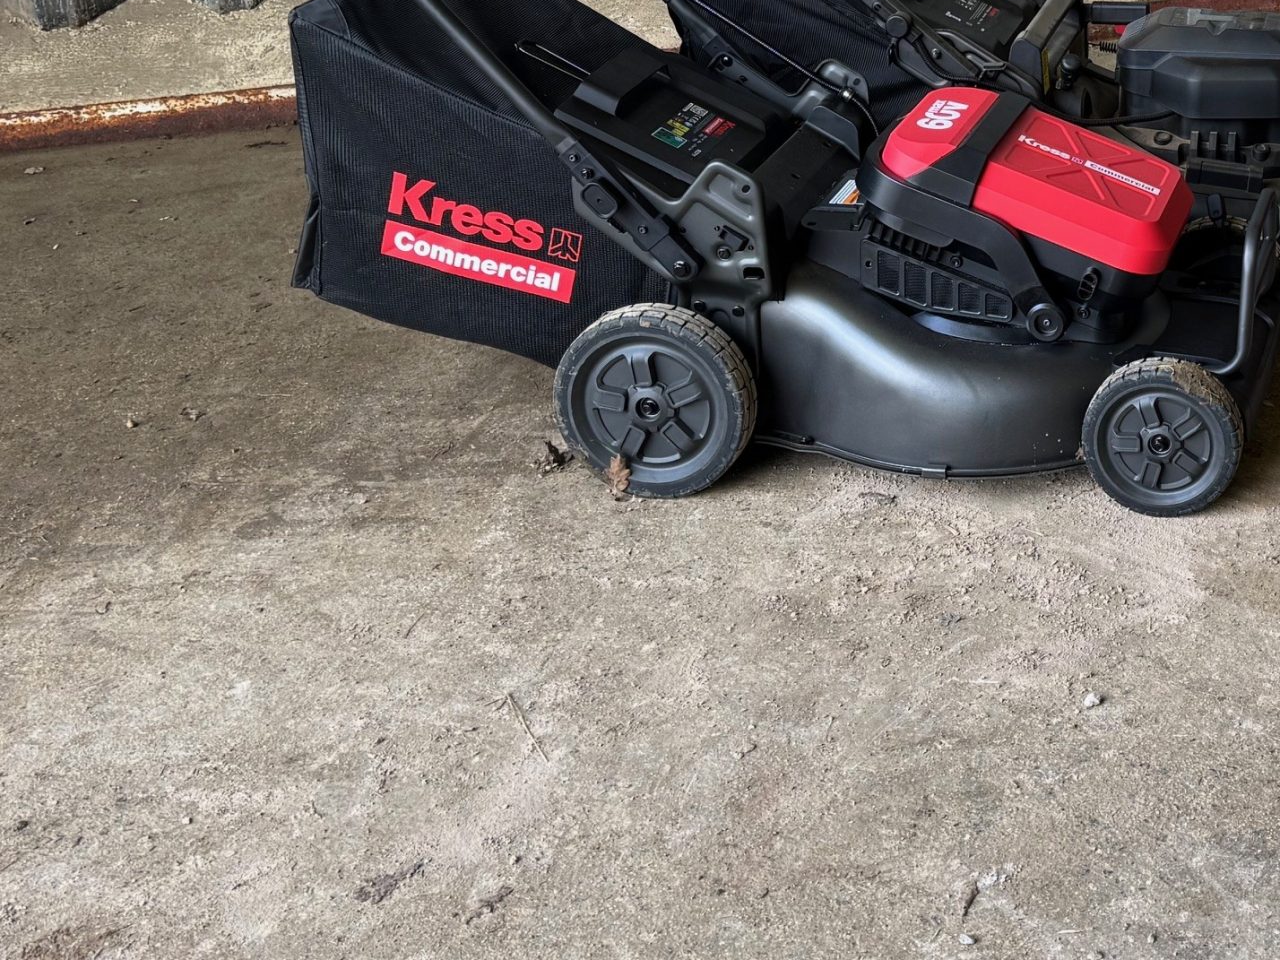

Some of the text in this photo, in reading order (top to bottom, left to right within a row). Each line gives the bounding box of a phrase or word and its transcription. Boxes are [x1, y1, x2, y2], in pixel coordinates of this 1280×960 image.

[916, 100, 969, 130] 60V
[1018, 134, 1156, 193] Kress Commercial
[387, 171, 545, 251] Kress
[394, 230, 561, 292] Commercial
